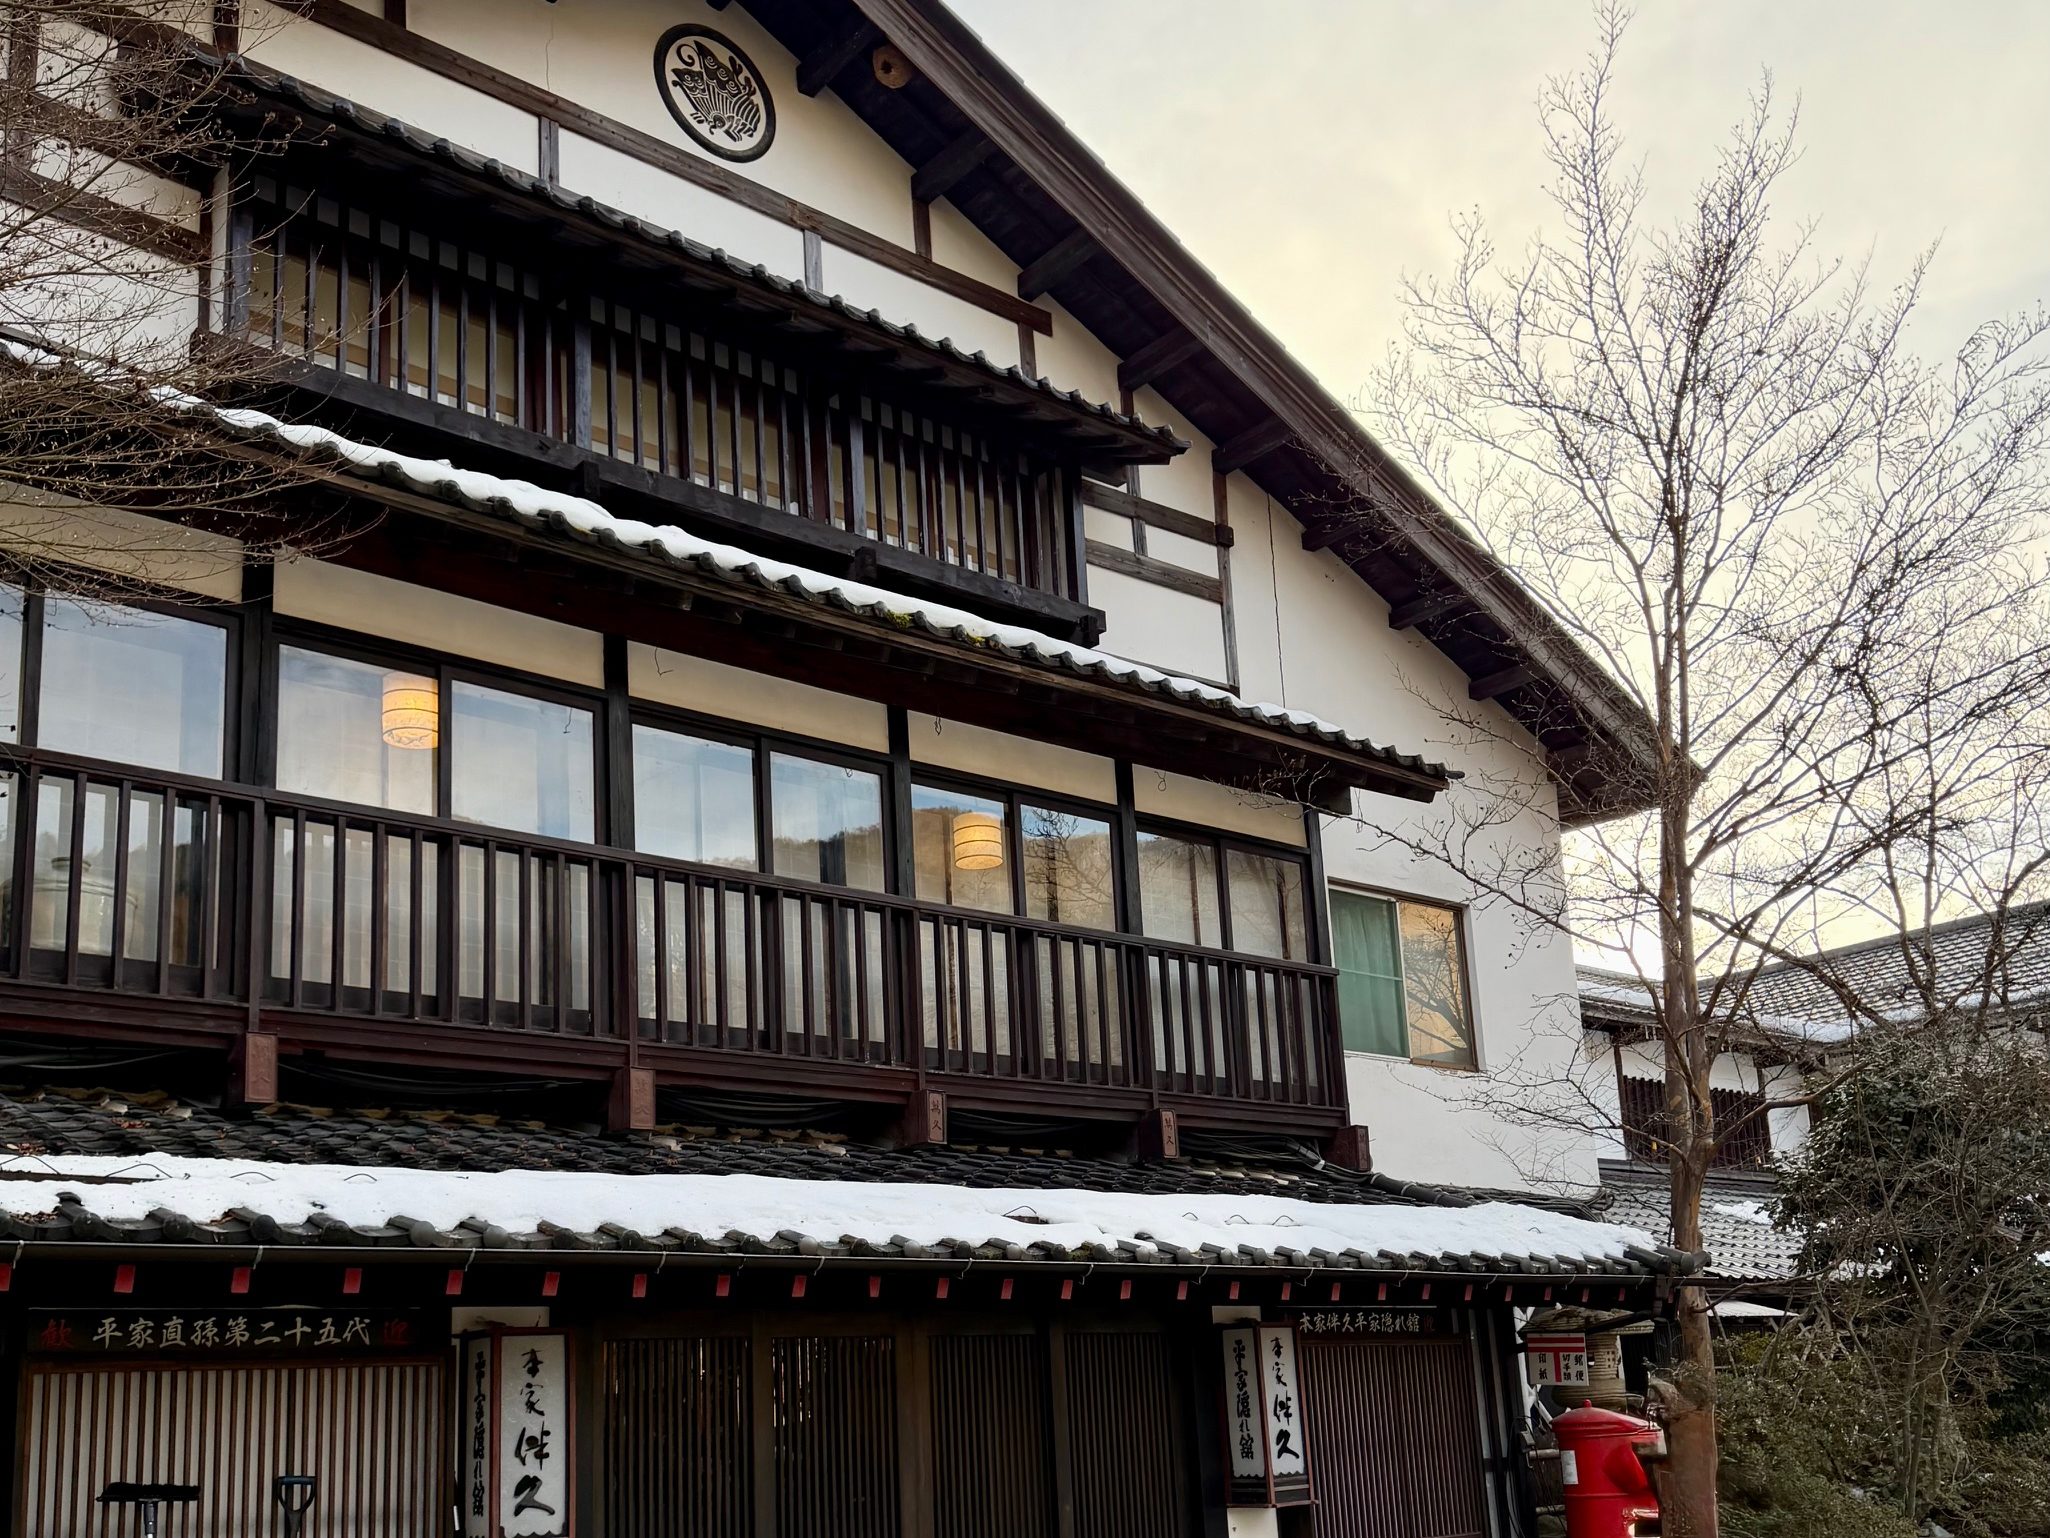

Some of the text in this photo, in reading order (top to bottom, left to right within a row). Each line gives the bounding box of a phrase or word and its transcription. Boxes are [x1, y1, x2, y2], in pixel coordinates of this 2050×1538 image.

[92, 1316, 370, 1349] 平家直孫第二十五代
